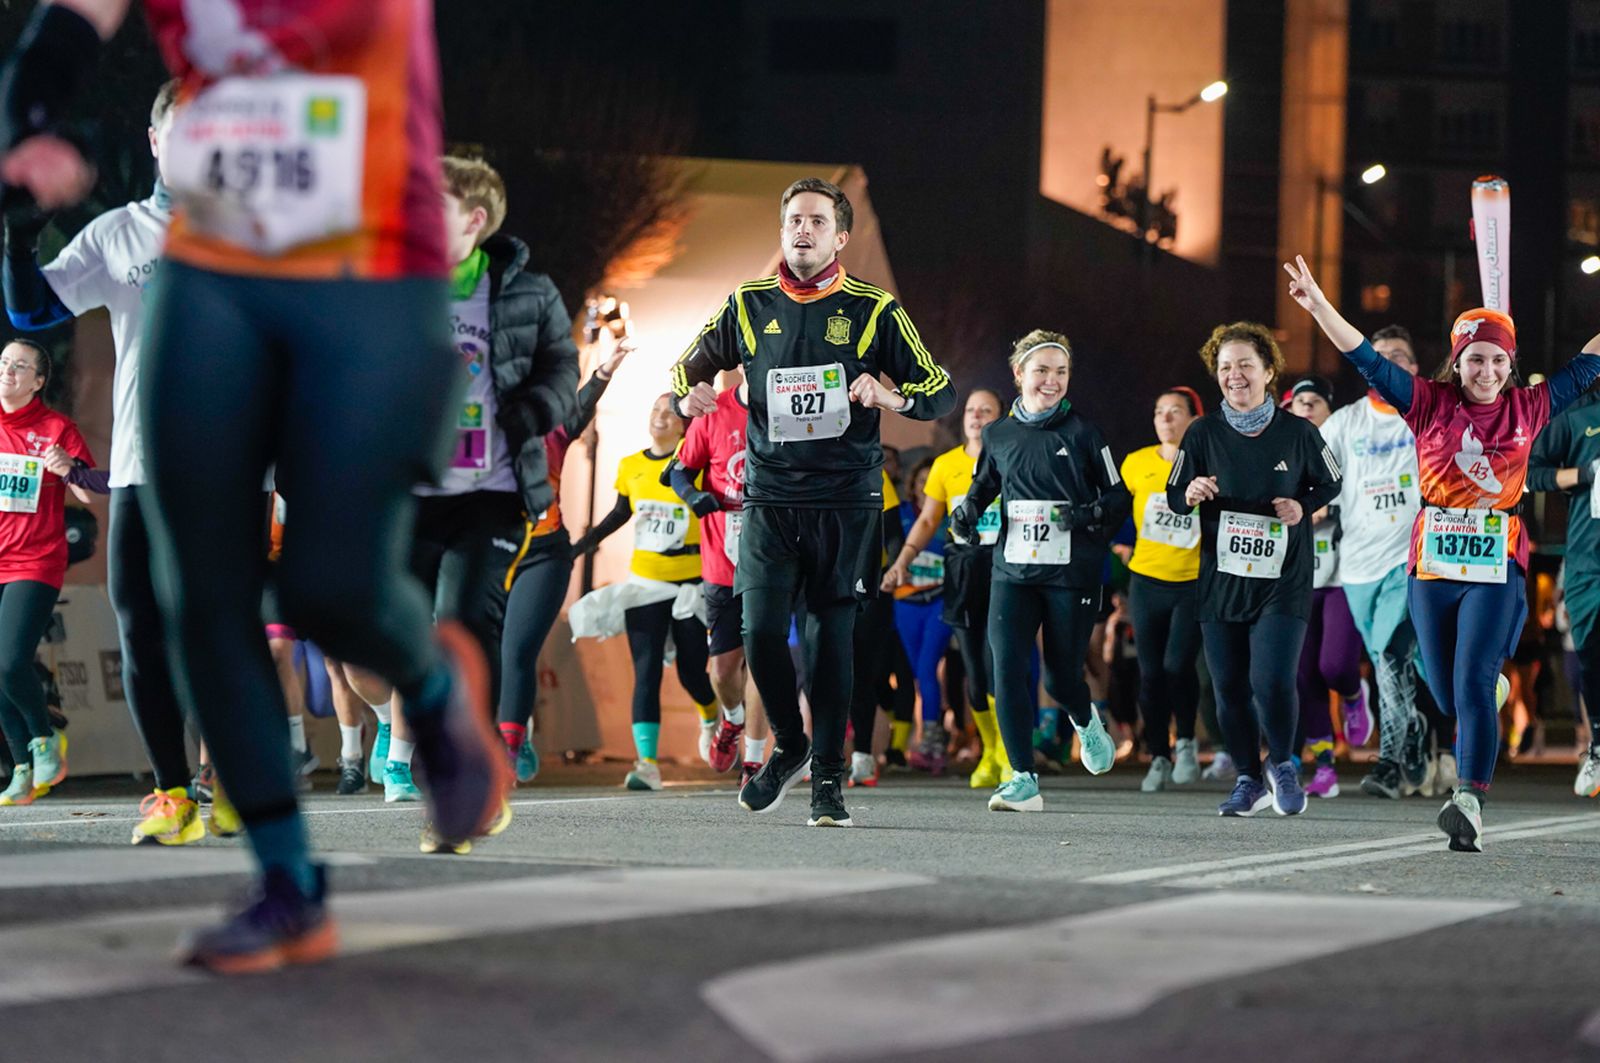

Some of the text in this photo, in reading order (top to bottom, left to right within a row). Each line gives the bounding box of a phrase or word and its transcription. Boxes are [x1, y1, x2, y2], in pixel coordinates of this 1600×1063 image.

[784, 374, 816, 384] NOCHE DE
[776, 385, 791, 394] SAN
[791, 392, 826, 416] 827
[1469, 461, 1489, 481] 43
[0, 474, 30, 493] 049
[1373, 491, 1406, 510] 2714
[977, 511, 998, 527] 62
[1155, 511, 1193, 530] 2269
[1235, 520, 1256, 529] NOCHE
[1023, 523, 1050, 542] 512
[1227, 526, 1241, 534] SAN
[1229, 535, 1276, 558] 6588
[1435, 533, 1496, 557] 13762
